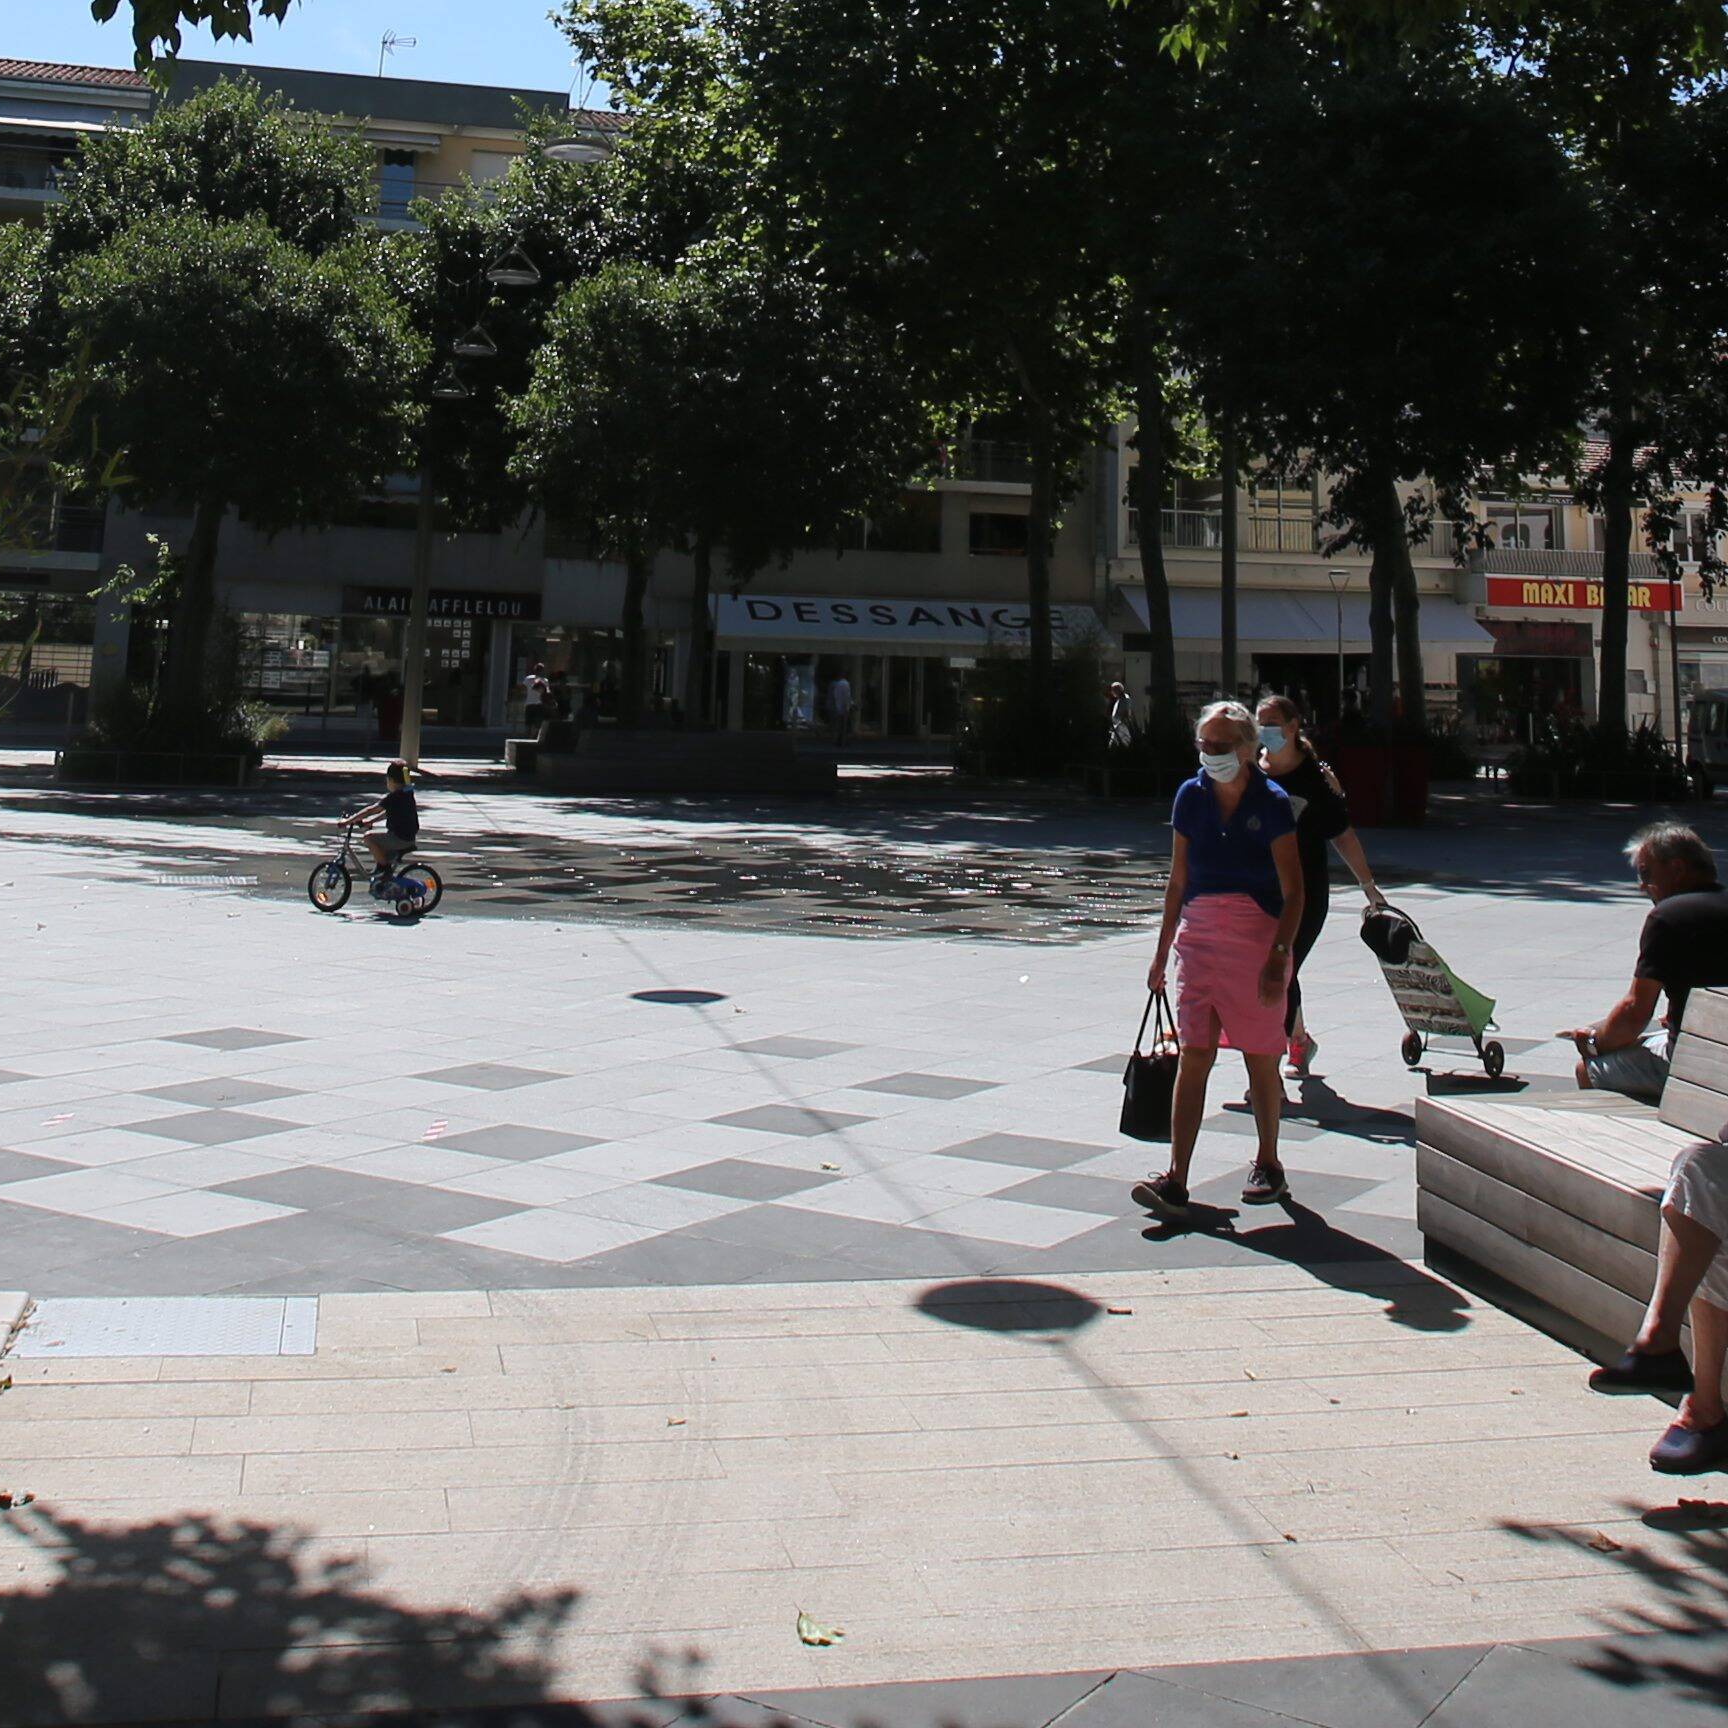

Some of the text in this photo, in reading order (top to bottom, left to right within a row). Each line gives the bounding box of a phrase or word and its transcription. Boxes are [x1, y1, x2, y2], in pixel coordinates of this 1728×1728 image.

[364, 596, 521, 616] ALAI AFFLELOU
[1522, 582, 1652, 609] MAXI BAR
